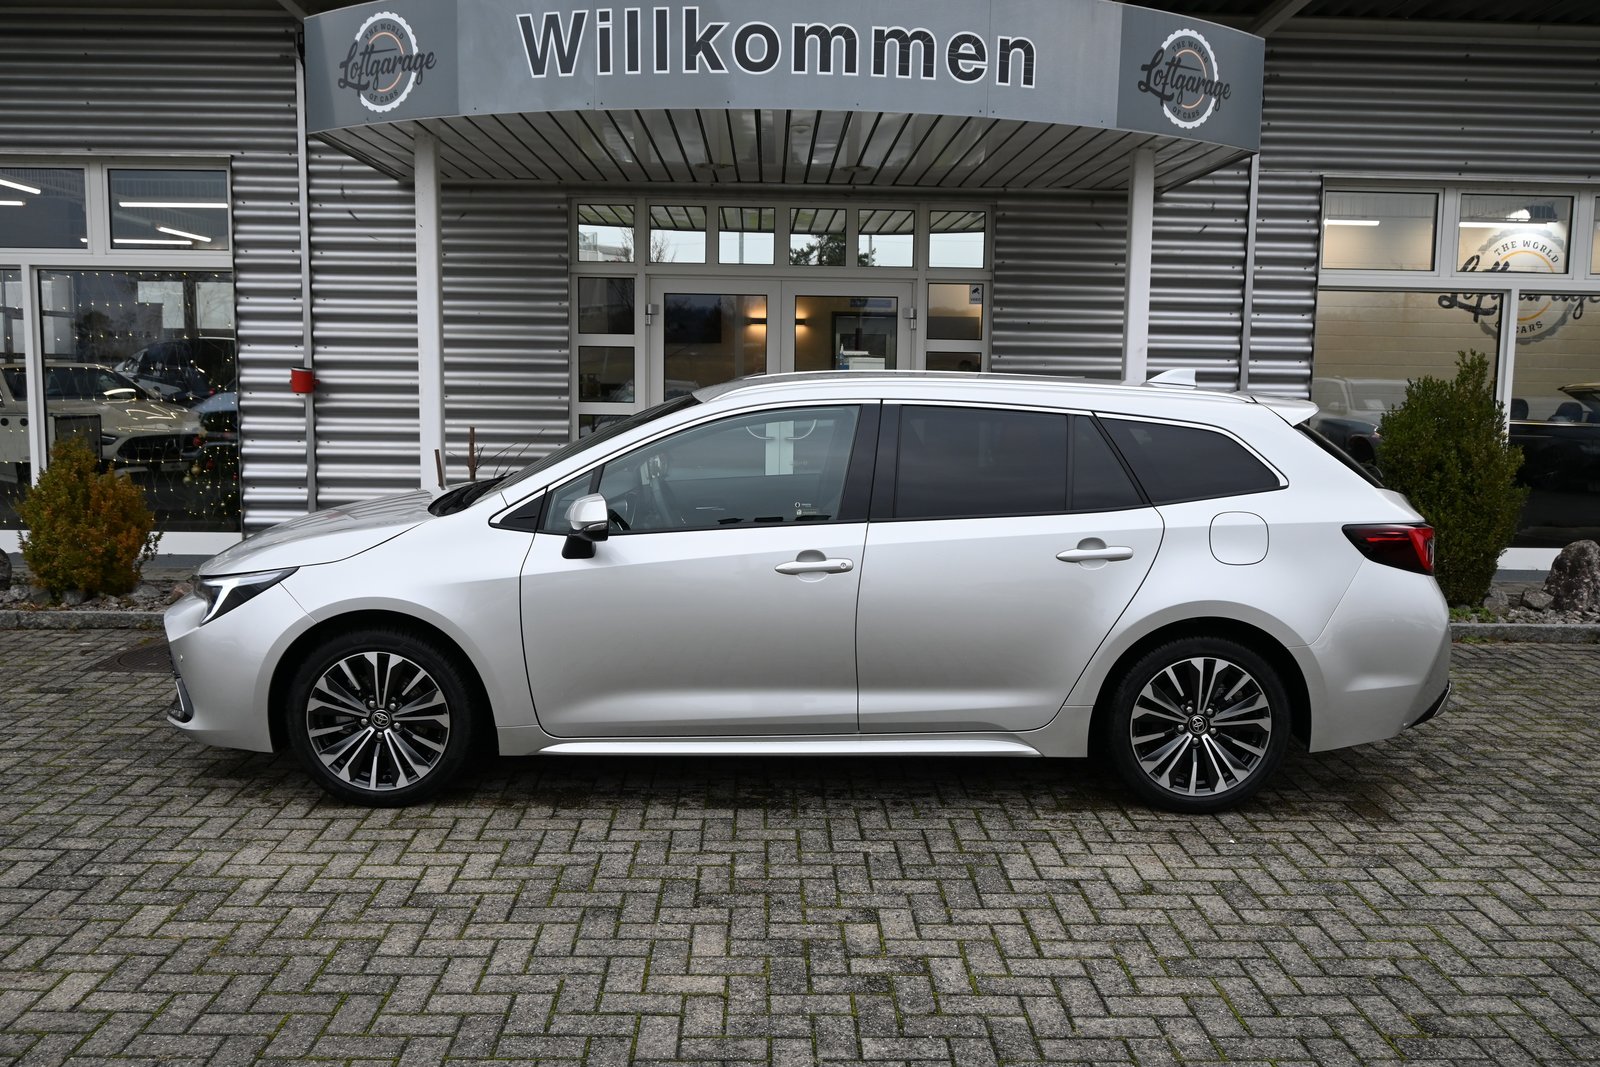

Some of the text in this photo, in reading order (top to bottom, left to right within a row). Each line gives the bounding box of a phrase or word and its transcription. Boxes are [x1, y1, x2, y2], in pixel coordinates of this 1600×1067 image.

[365, 23, 404, 40] THE WORLD
[515, 6, 1037, 89] Willkommen
[1172, 40, 1209, 64] THE WORLD
[337, 40, 437, 97] Loftgarage
[1137, 48, 1232, 112] Loftgarage
[369, 90, 399, 103] OF CARS
[1172, 106, 1200, 119] OF CARS
[1494, 240, 1517, 256] THE
[1522, 239, 1560, 264] WORLD
